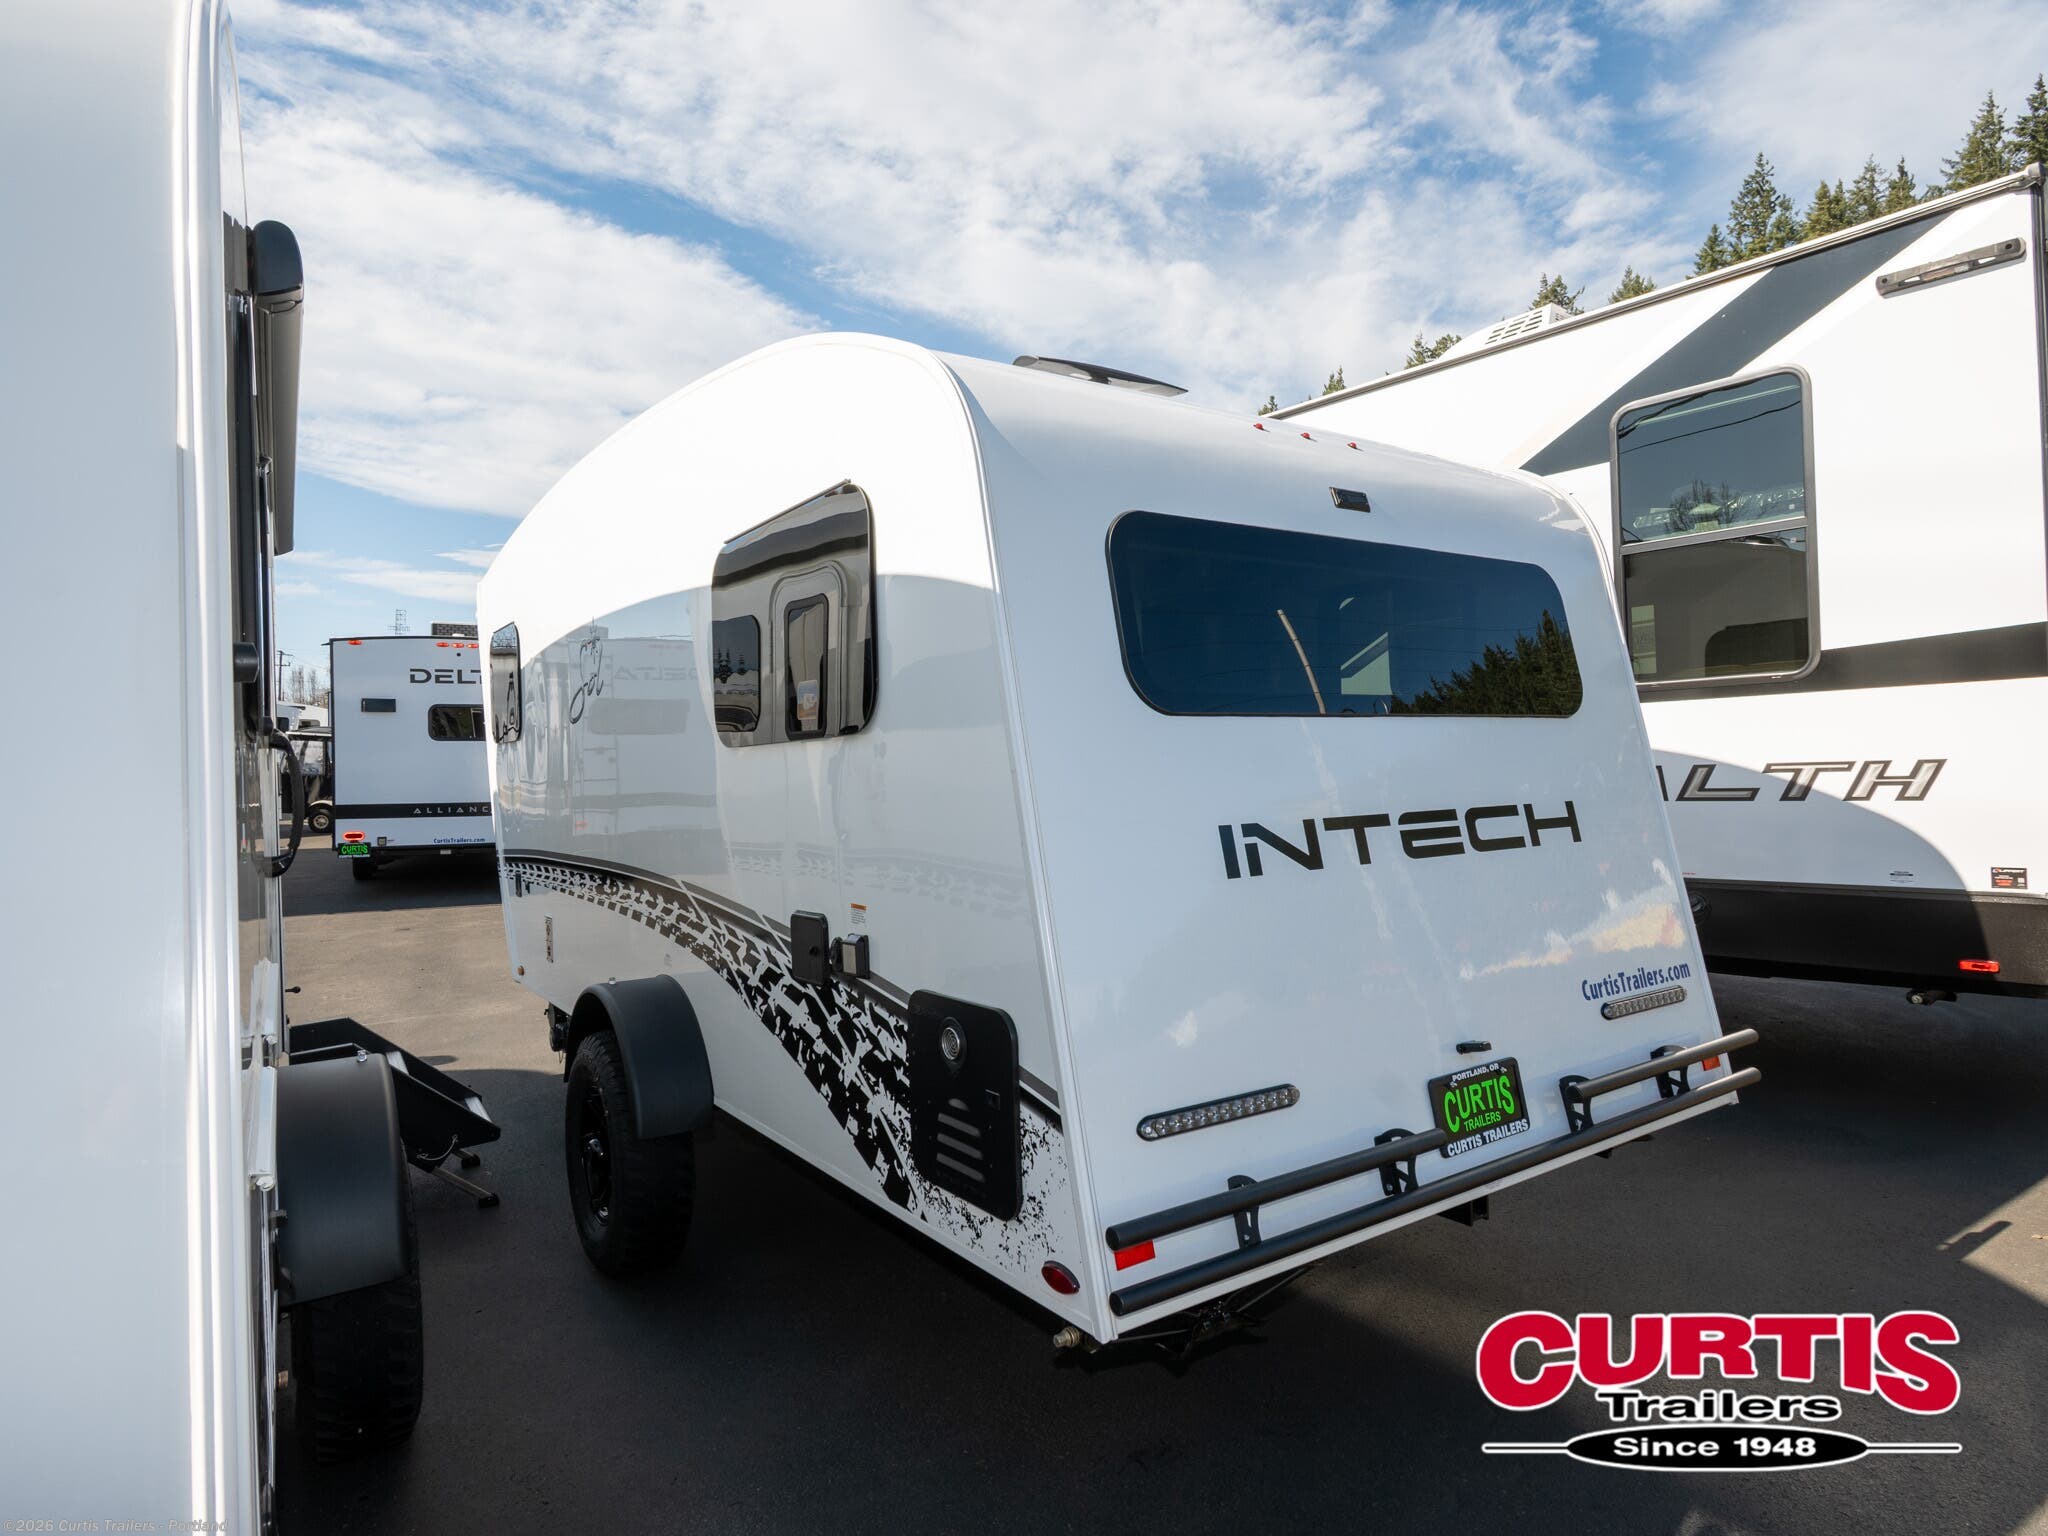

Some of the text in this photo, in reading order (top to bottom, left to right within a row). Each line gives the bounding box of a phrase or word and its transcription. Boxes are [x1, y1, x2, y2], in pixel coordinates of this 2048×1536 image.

[1656, 759, 1947, 801] LTH
[413, 806, 492, 814] ALLIANC
[1218, 801, 1581, 879] INTECH
[1582, 963, 1690, 1000] CurtisTrailers.com
[1489, 1063, 1499, 1072] OR
[1444, 1075, 1515, 1133] CURTIS
[1464, 1111, 1501, 1132] TRAILERS
[1447, 1119, 1529, 1157] CURTIS TRAILERS
